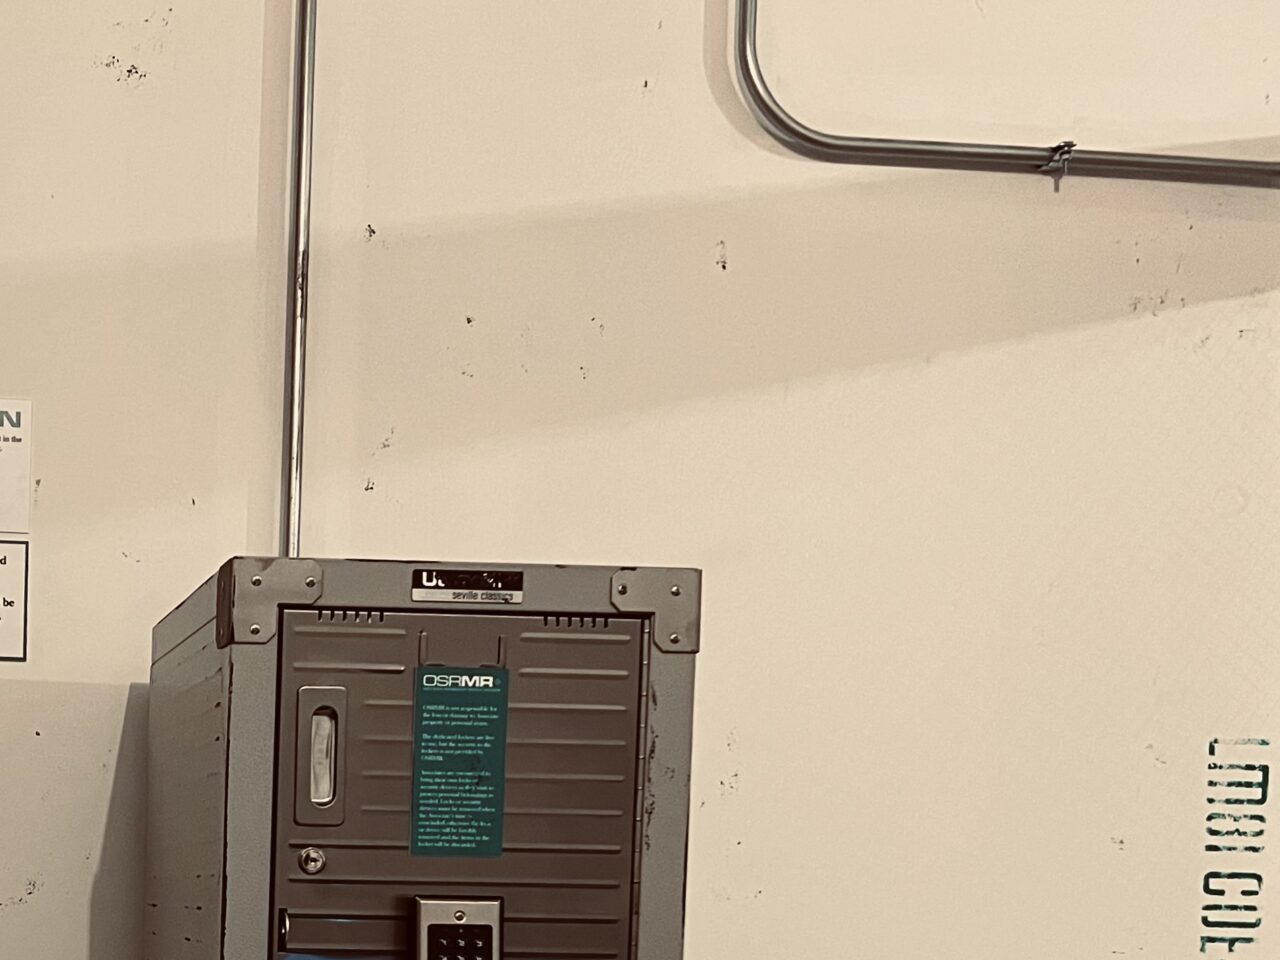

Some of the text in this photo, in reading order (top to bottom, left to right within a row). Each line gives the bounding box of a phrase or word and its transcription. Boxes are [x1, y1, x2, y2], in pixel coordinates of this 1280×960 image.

[11, 435, 22, 443] the
[3, 598, 15, 607] be
[423, 674, 493, 688] OSRMR
